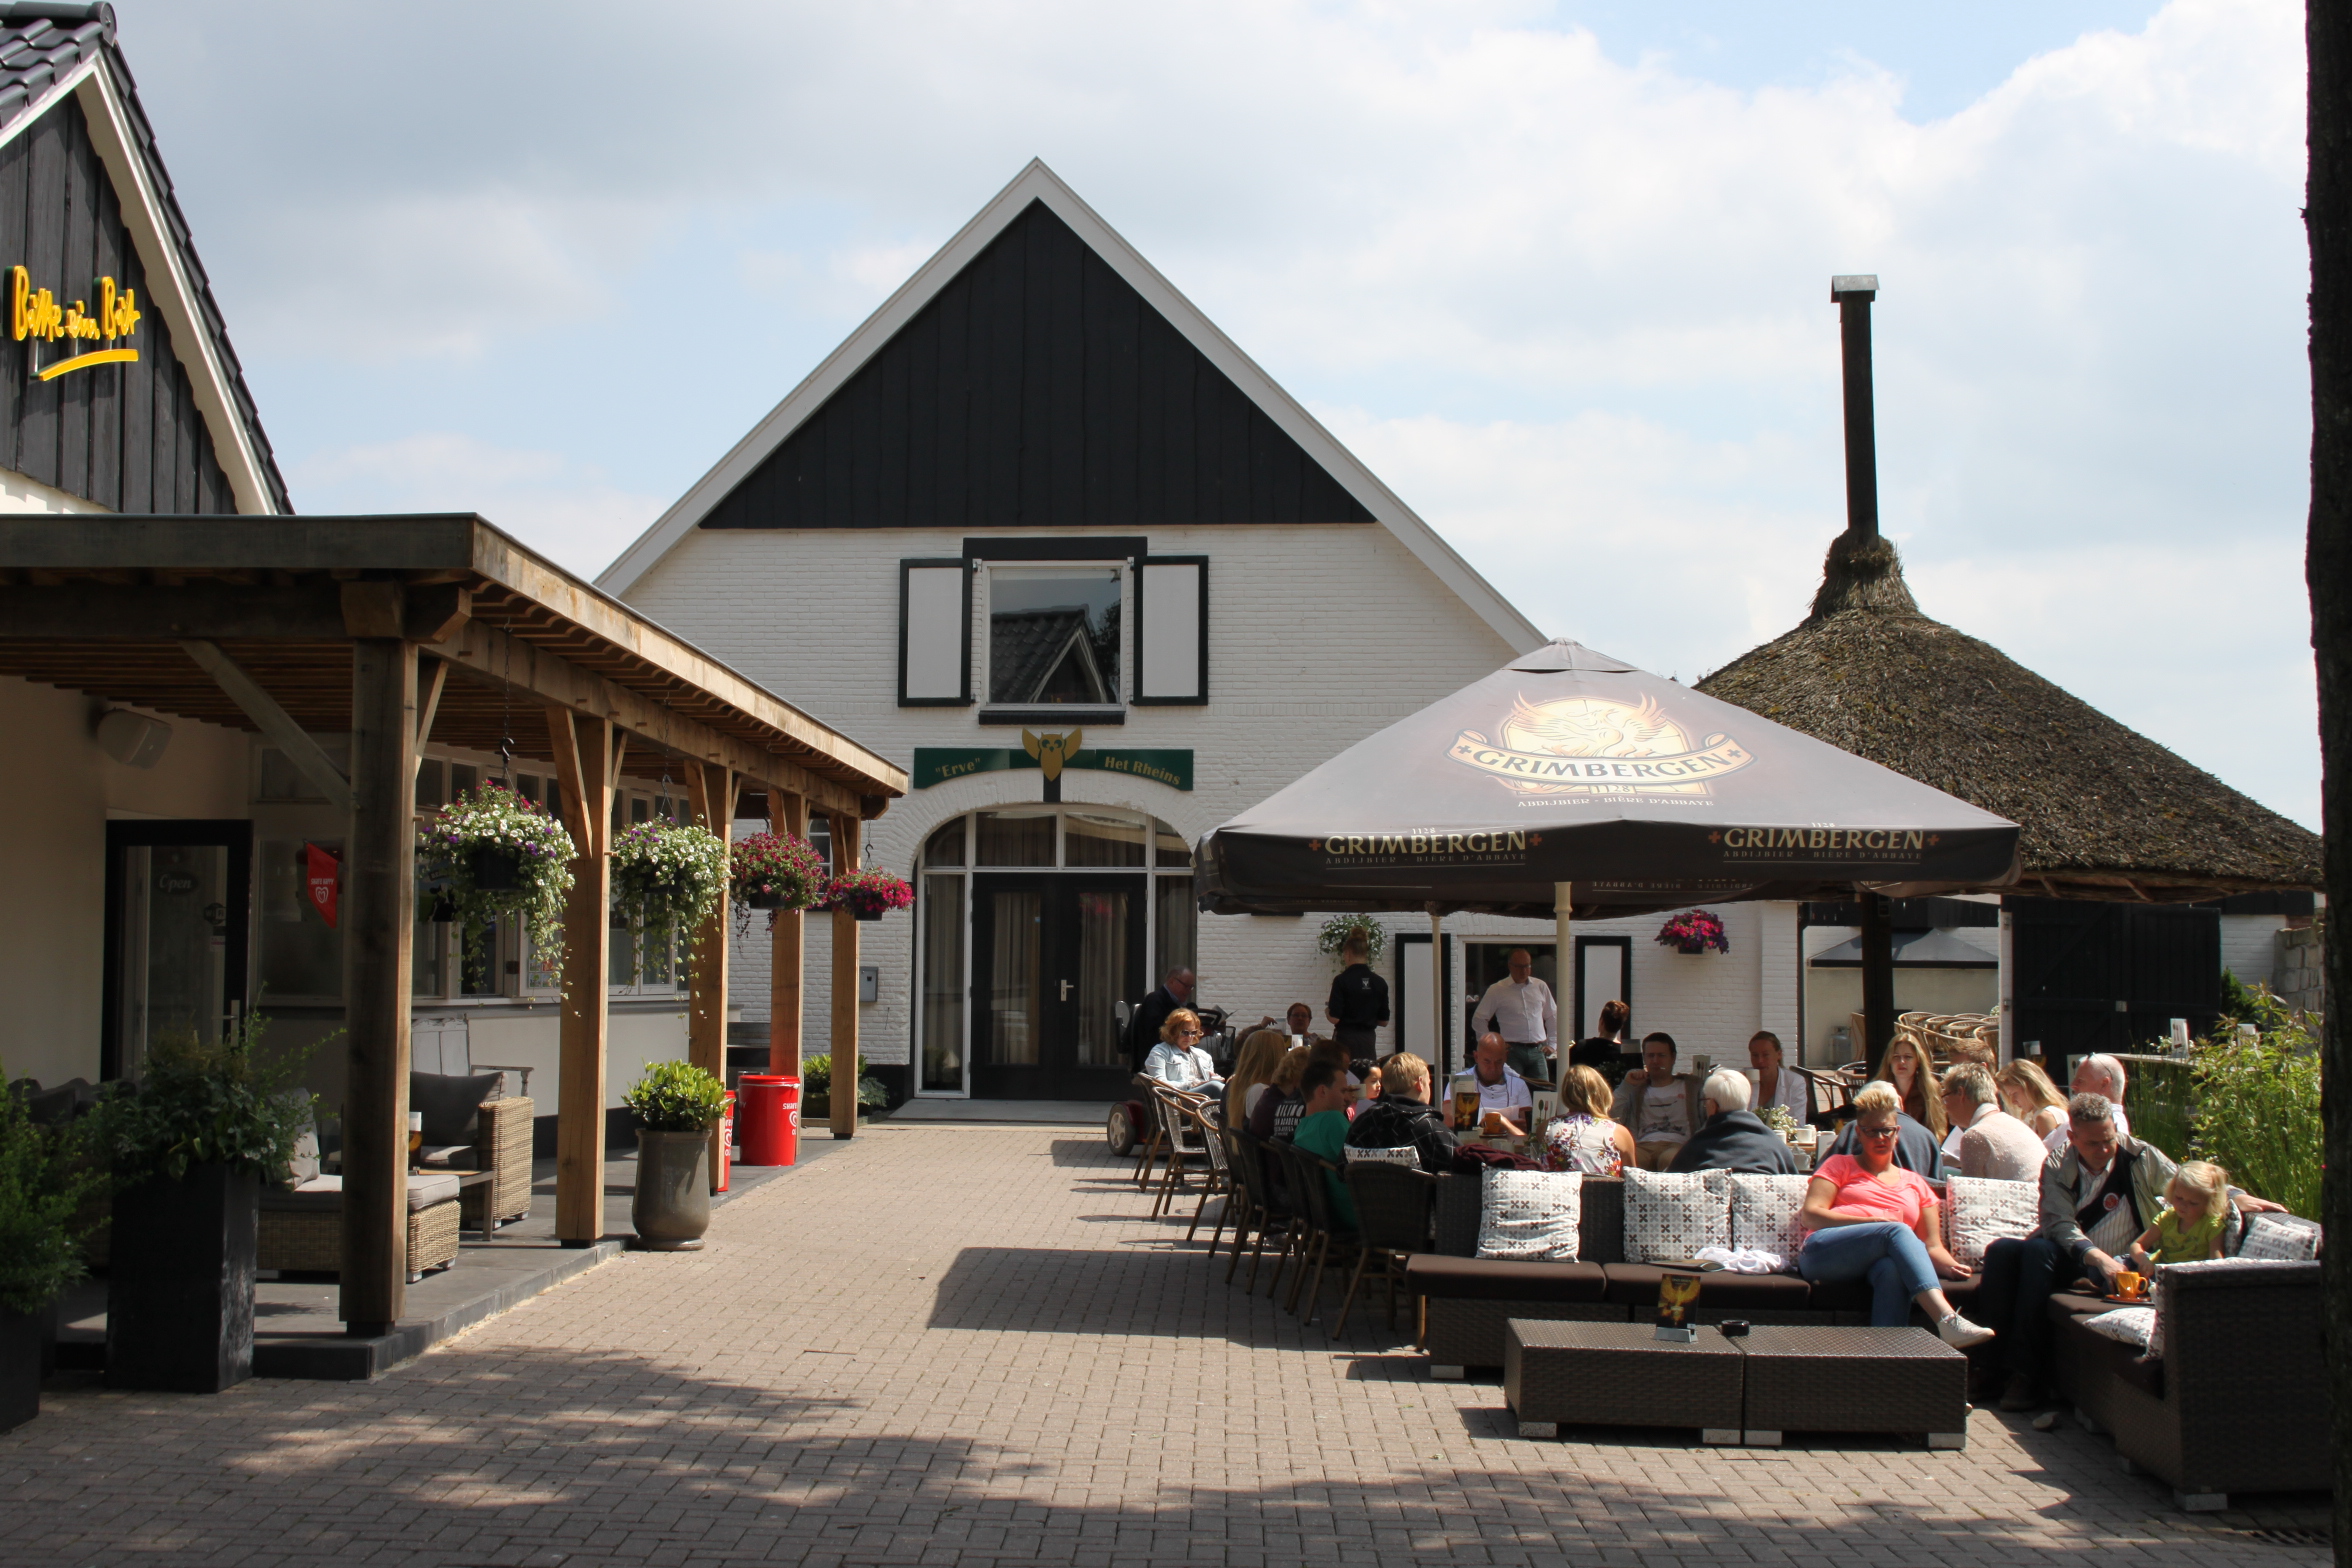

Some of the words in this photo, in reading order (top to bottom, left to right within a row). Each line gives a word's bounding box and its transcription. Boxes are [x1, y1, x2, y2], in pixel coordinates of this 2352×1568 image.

[11, 265, 65, 342] Bitte
[65, 300, 100, 340] ein
[100, 276, 141, 340] Bit
[1104, 756, 1129, 771] Het
[1132, 761, 1181, 785] Rheins
[1472, 751, 1732, 778] GRIMBERGEN
[1517, 798, 1590, 807] ABDIJBIER
[1603, 795, 1644, 803] BIÈRE
[1649, 798, 1714, 806] D'ABBAYE
[1324, 830, 1526, 855] GRIMBERGEN
[1724, 828, 1924, 850] GRIMBERGEN
[1325, 856, 1396, 864] ABDIJBIER
[1463, 853, 1526, 861] D'ABBAYE
[1723, 850, 1793, 858] ABDIJBIER
[1859, 851, 1922, 859] D'ABBAYE
[159, 873, 192, 892] Open
